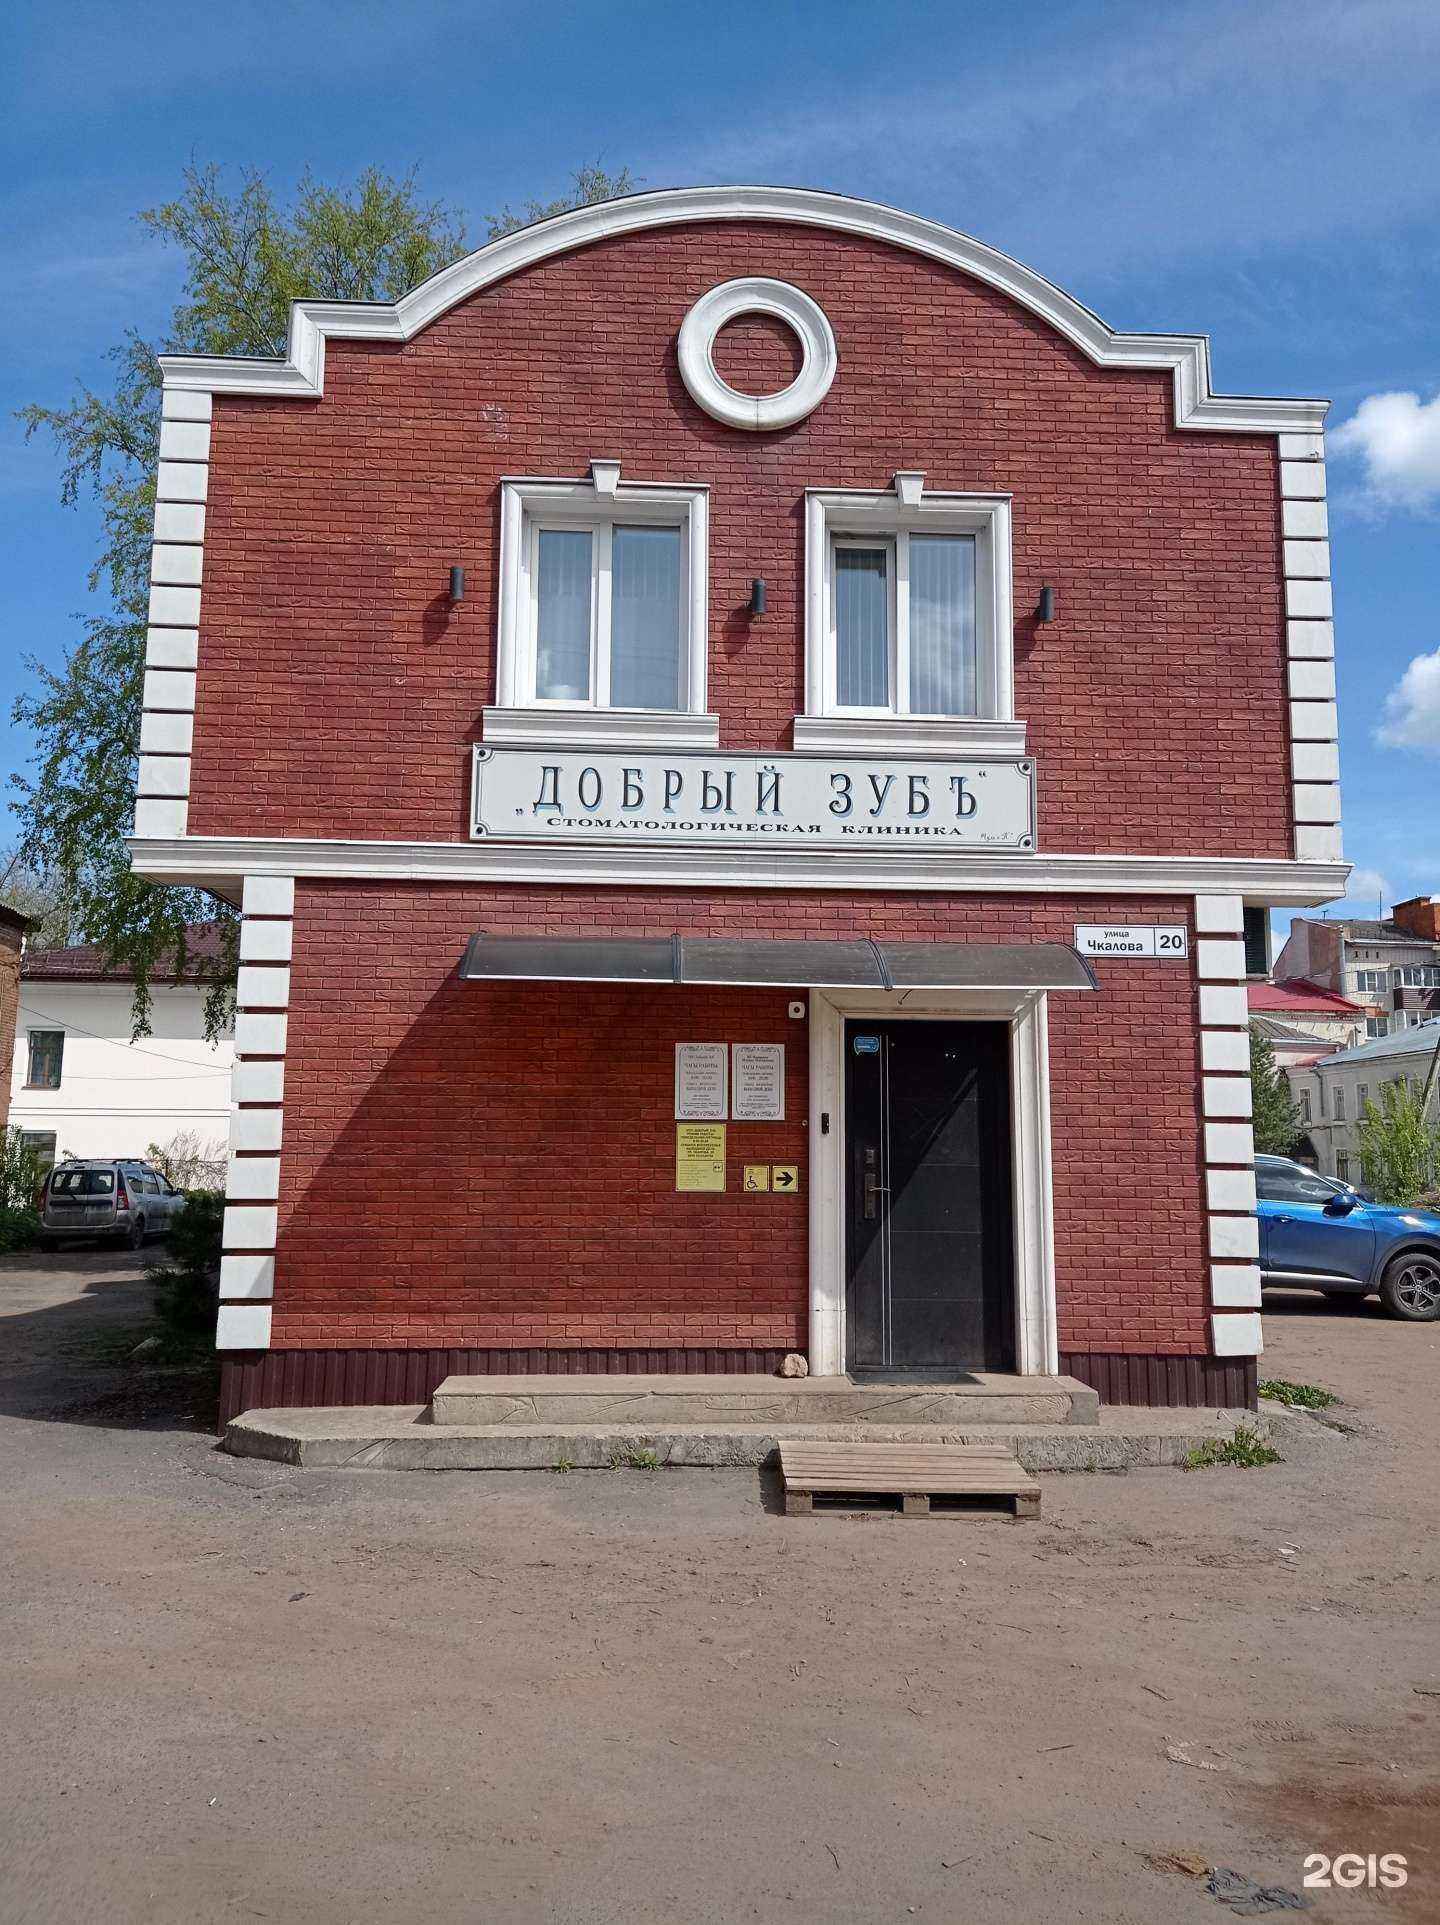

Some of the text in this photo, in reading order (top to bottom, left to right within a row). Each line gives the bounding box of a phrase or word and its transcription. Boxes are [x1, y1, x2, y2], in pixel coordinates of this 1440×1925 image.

[546, 817, 963, 836] СТОМАТОЛОГИЧЕСКАЯ КЛИНИКА
[1103, 930, 1130, 939] улица
[1159, 934, 1183, 949] 20
[1087, 939, 1144, 952] Чкалова
